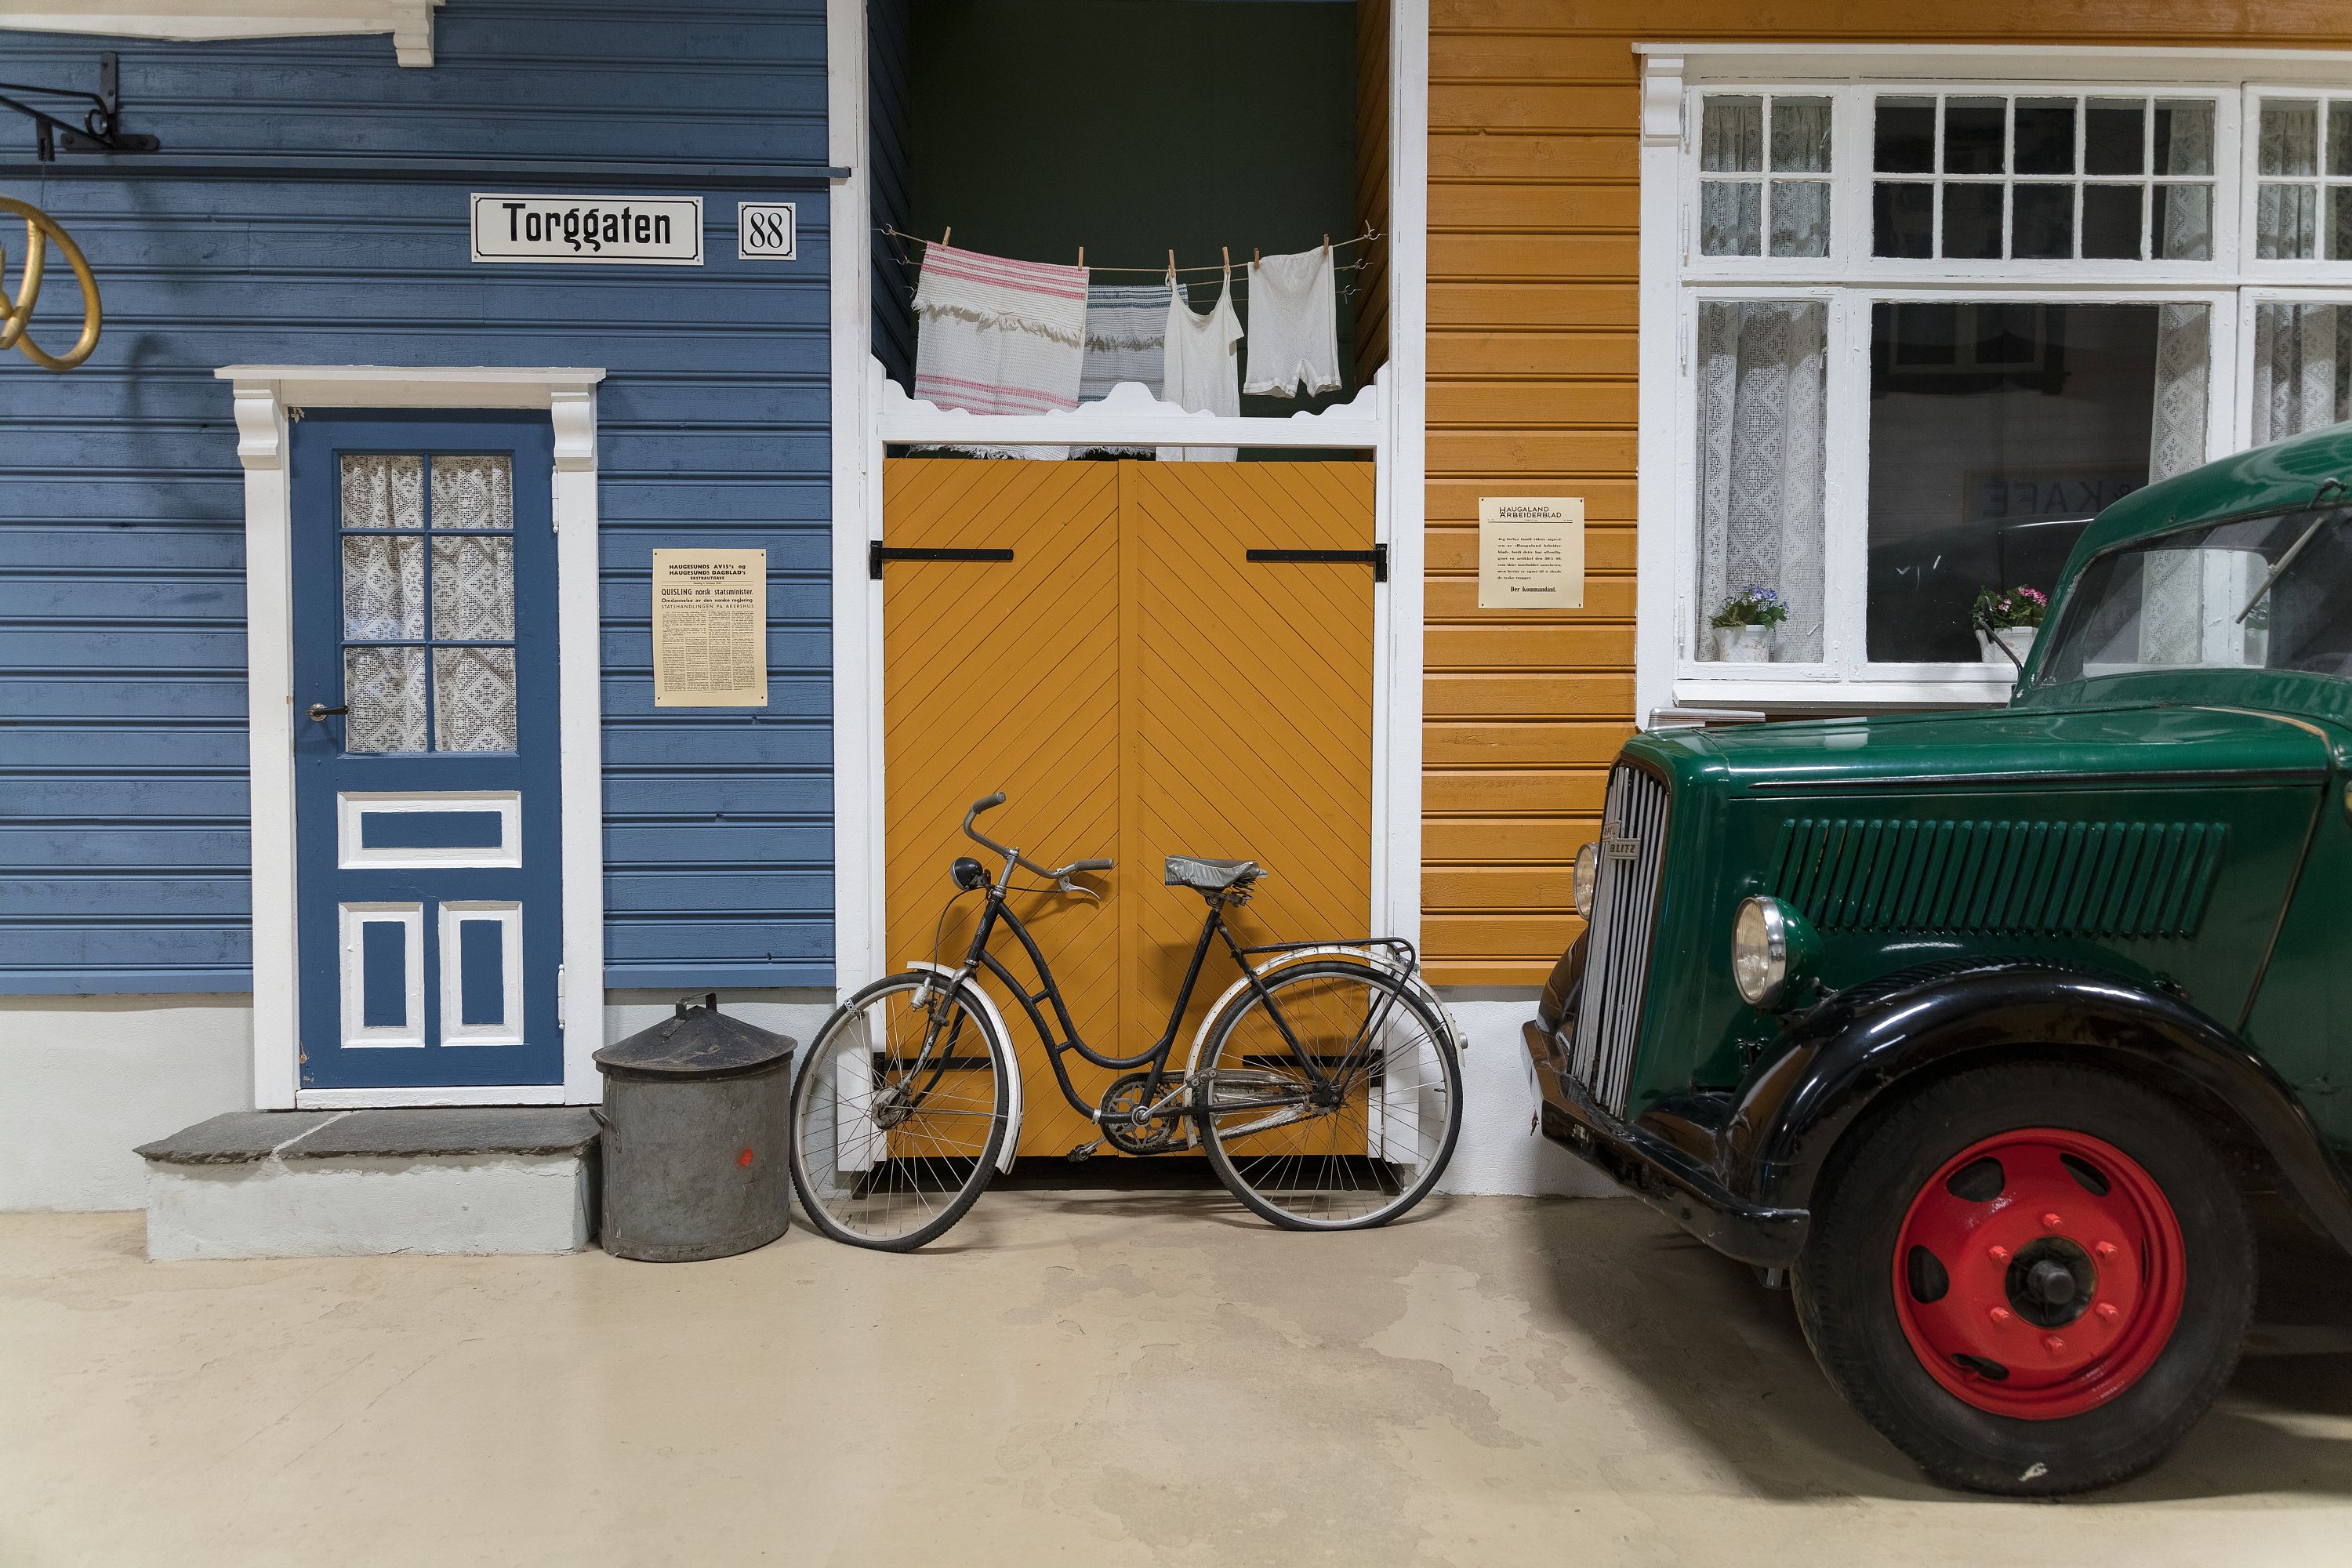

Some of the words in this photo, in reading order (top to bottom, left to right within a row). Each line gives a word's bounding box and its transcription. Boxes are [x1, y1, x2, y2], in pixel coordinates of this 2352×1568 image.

[502, 203, 671, 252] Torggaten
[749, 212, 783, 248] 88
[1610, 844, 1635, 853] BLITZ
